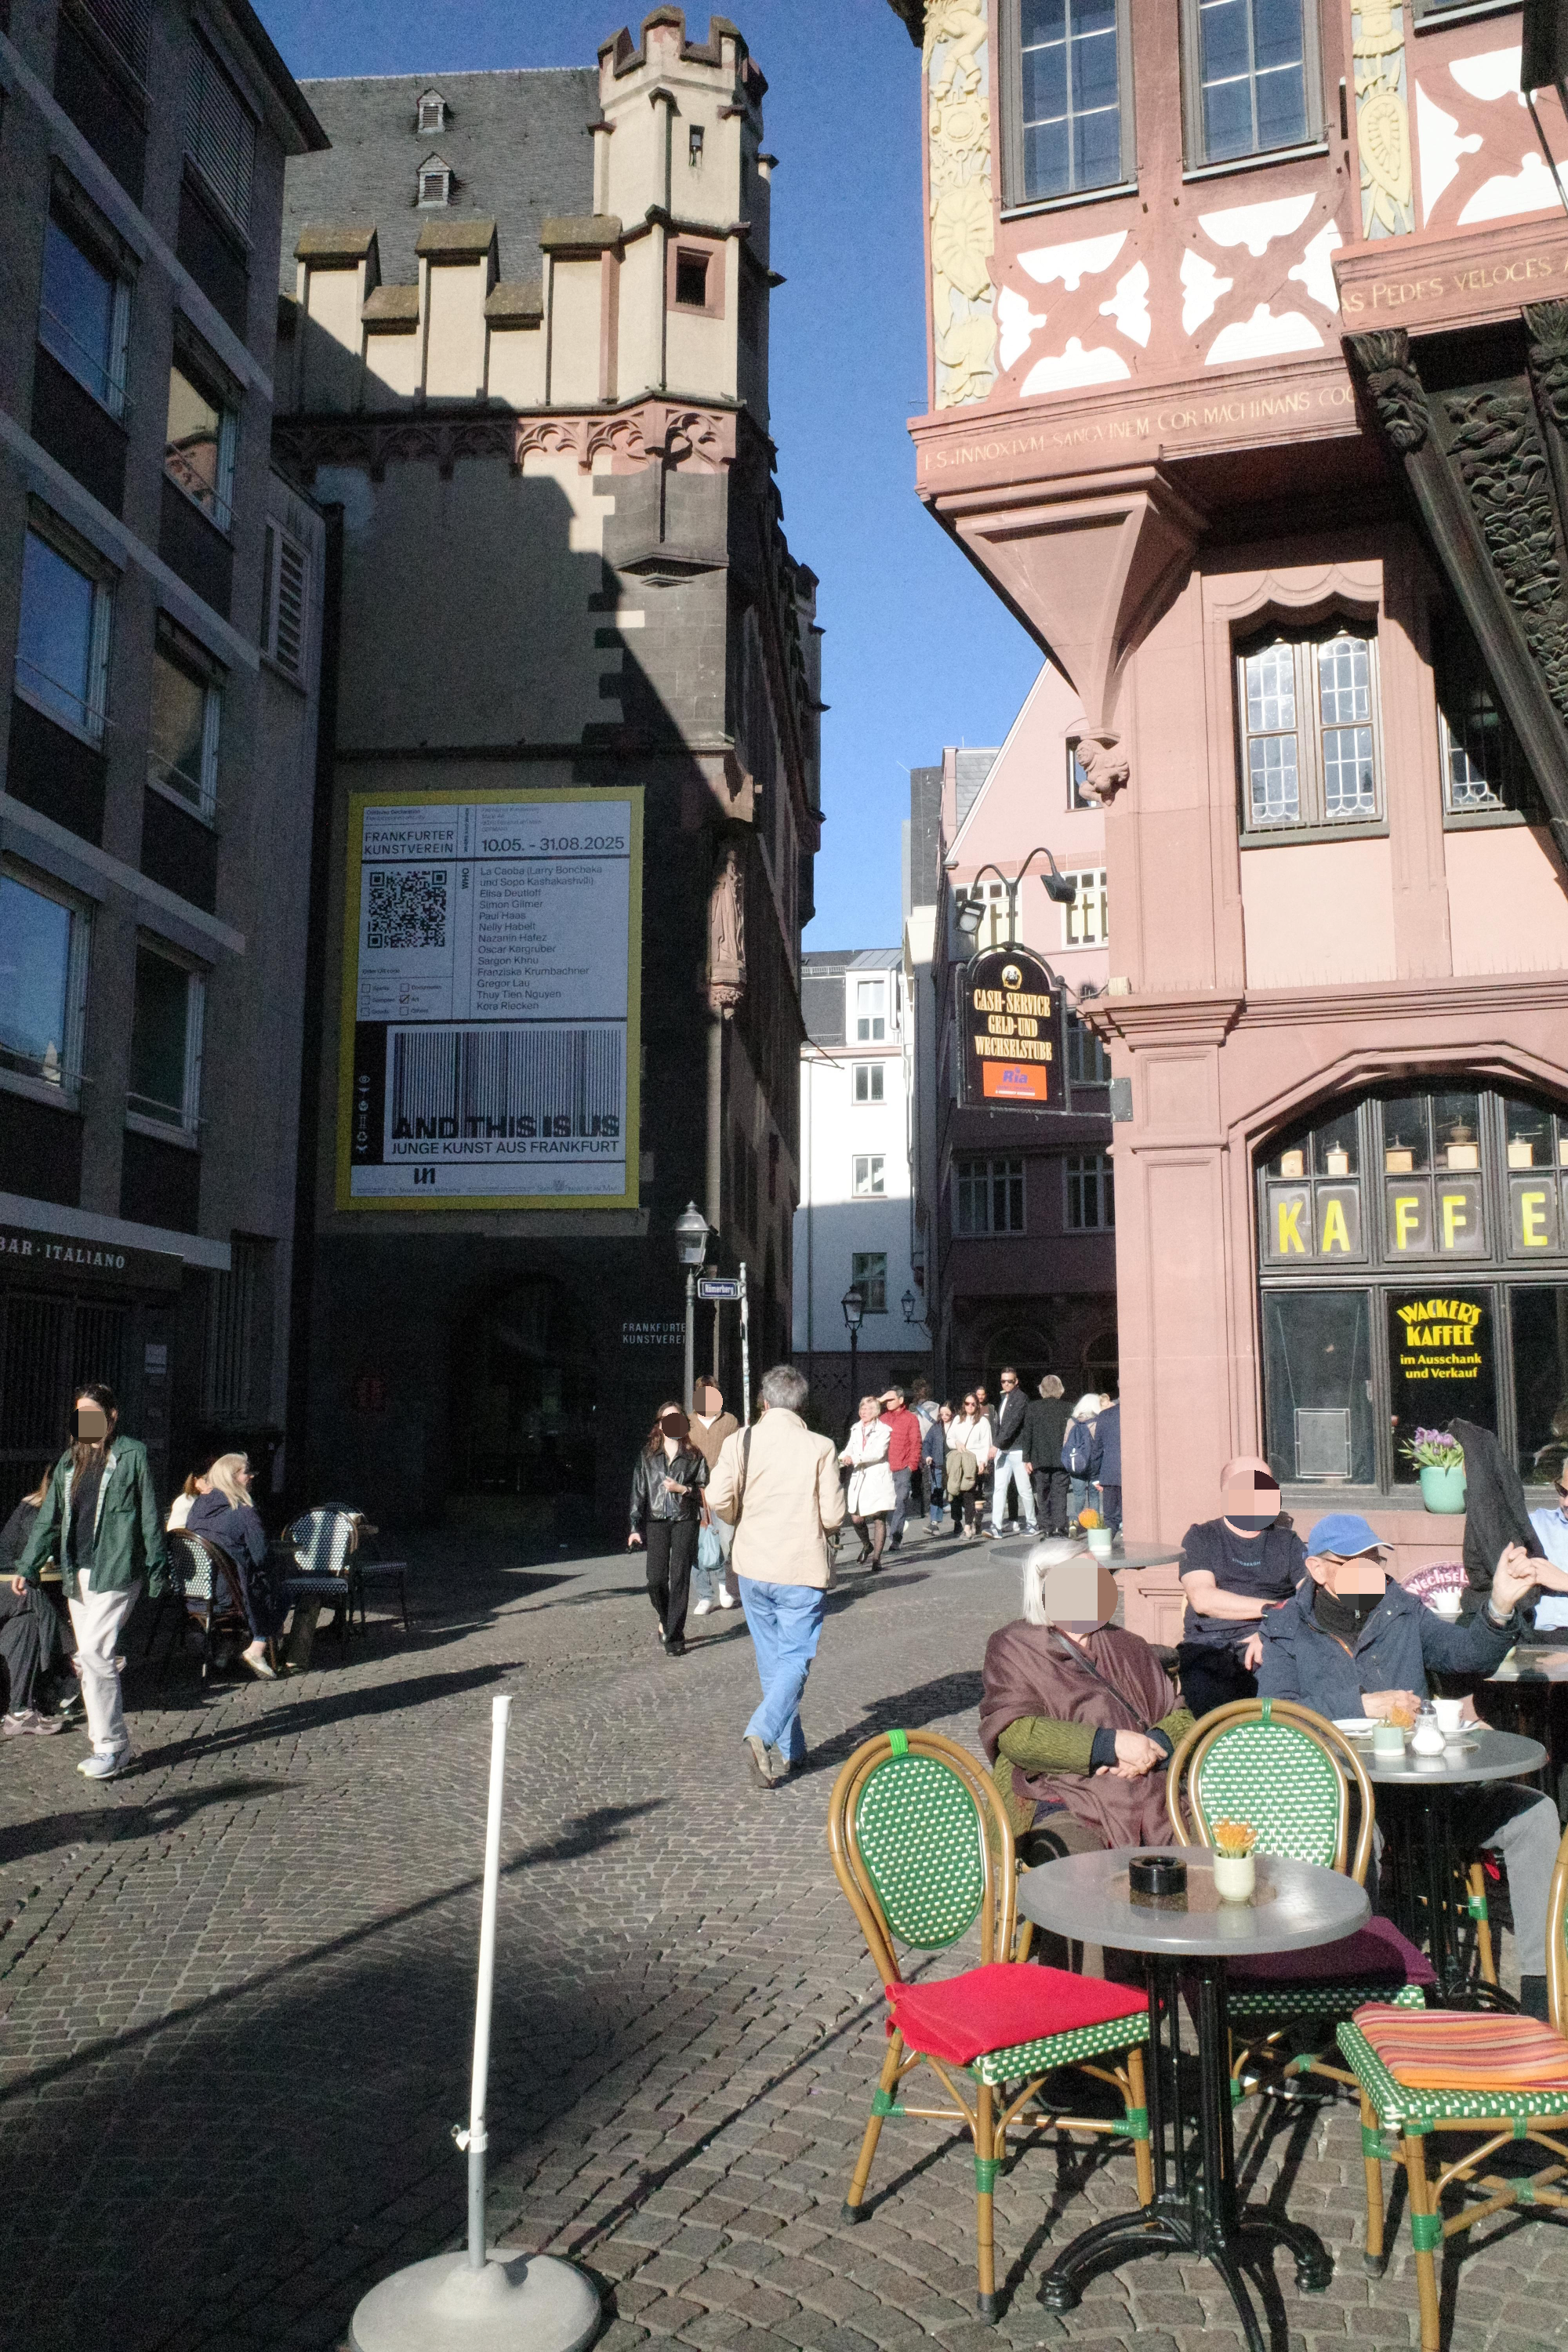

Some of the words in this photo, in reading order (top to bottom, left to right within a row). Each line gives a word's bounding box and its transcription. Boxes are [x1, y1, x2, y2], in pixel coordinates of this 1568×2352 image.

[1373, 278, 1443, 308] PEDES
[1454, 256, 1552, 292] VELOCES
[1158, 409, 1198, 430] COR
[365, 830, 454, 842] FRANKFURTER
[364, 843, 453, 855] KUNSTVEREIN
[482, 838, 524, 852] 10.05.
[539, 836, 625, 851] 31.08.2025
[481, 867, 492, 876] La
[527, 866, 553, 877] (Larry
[500, 878, 524, 887] Sopo
[479, 923, 503, 933] Nelly
[478, 946, 506, 954] Oscar
[510, 945, 556, 955] Kargruber
[477, 956, 511, 966] Sargon
[477, 967, 522, 977] Franziska
[477, 979, 510, 989] Gregor
[477, 990, 499, 1000] Thuy
[524, 990, 561, 1000] Nguyen
[477, 1002, 498, 1011] Kora
[975, 1036, 1052, 1061] WECHSELSTUBE
[1003, 1066, 1028, 1083] Ria
[392, 1116, 459, 1138] AND
[467, 1115, 536, 1138] THIS
[543, 1114, 571, 1137] IS
[579, 1114, 620, 1137] US
[392, 1142, 439, 1154] JUNGE
[443, 1142, 493, 1154] KUNST
[496, 1142, 526, 1153] AUS
[530, 1141, 619, 1153] FRANKFURT
[45, 1244, 125, 1269] ITALIANO
[706, 1283, 735, 1295] Römerberg
[1396, 1298, 1482, 1326] WACKER'S
[622, 1323, 687, 1333] FRANKFURTE
[622, 1334, 685, 1345] KUNSTVEREI
[1406, 1325, 1475, 1346] KAFFEE
[1400, 1354, 1417, 1365] im
[1417, 1353, 1482, 1365] Ausschank
[1406, 1367, 1428, 1378] und
[1431, 1367, 1478, 1378] Verkauf
